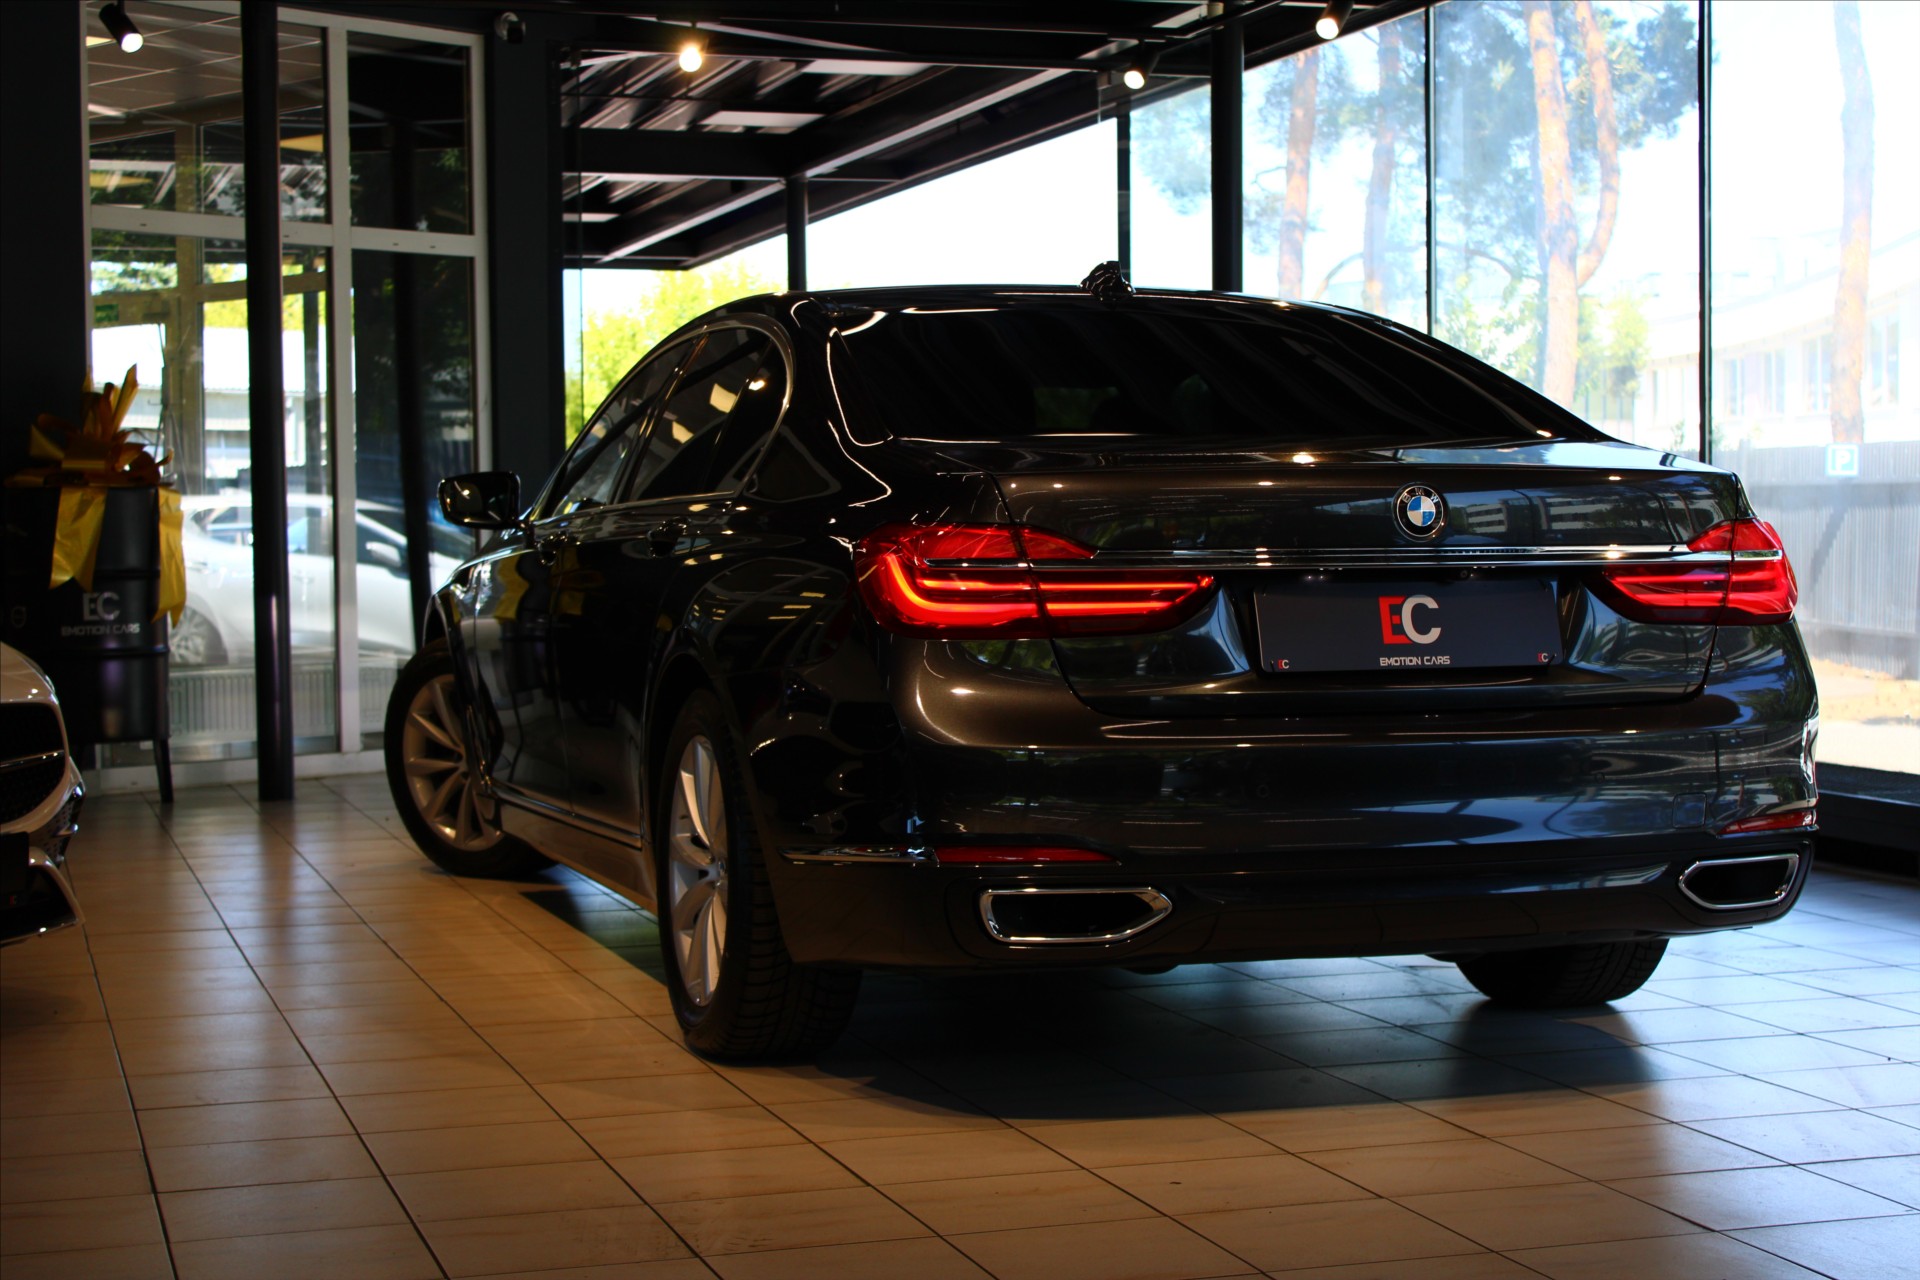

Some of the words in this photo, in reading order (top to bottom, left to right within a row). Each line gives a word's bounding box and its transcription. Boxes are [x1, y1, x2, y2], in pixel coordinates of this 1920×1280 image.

[1835, 449, 1851, 471] P
[1401, 487, 1440, 503] BMW
[82, 591, 121, 621] EC
[1378, 594, 1442, 645] EC
[61, 625, 110, 637] EMOTION
[112, 623, 140, 635] CARS
[1379, 656, 1422, 667] EMOTION
[1423, 655, 1451, 665] CARS
